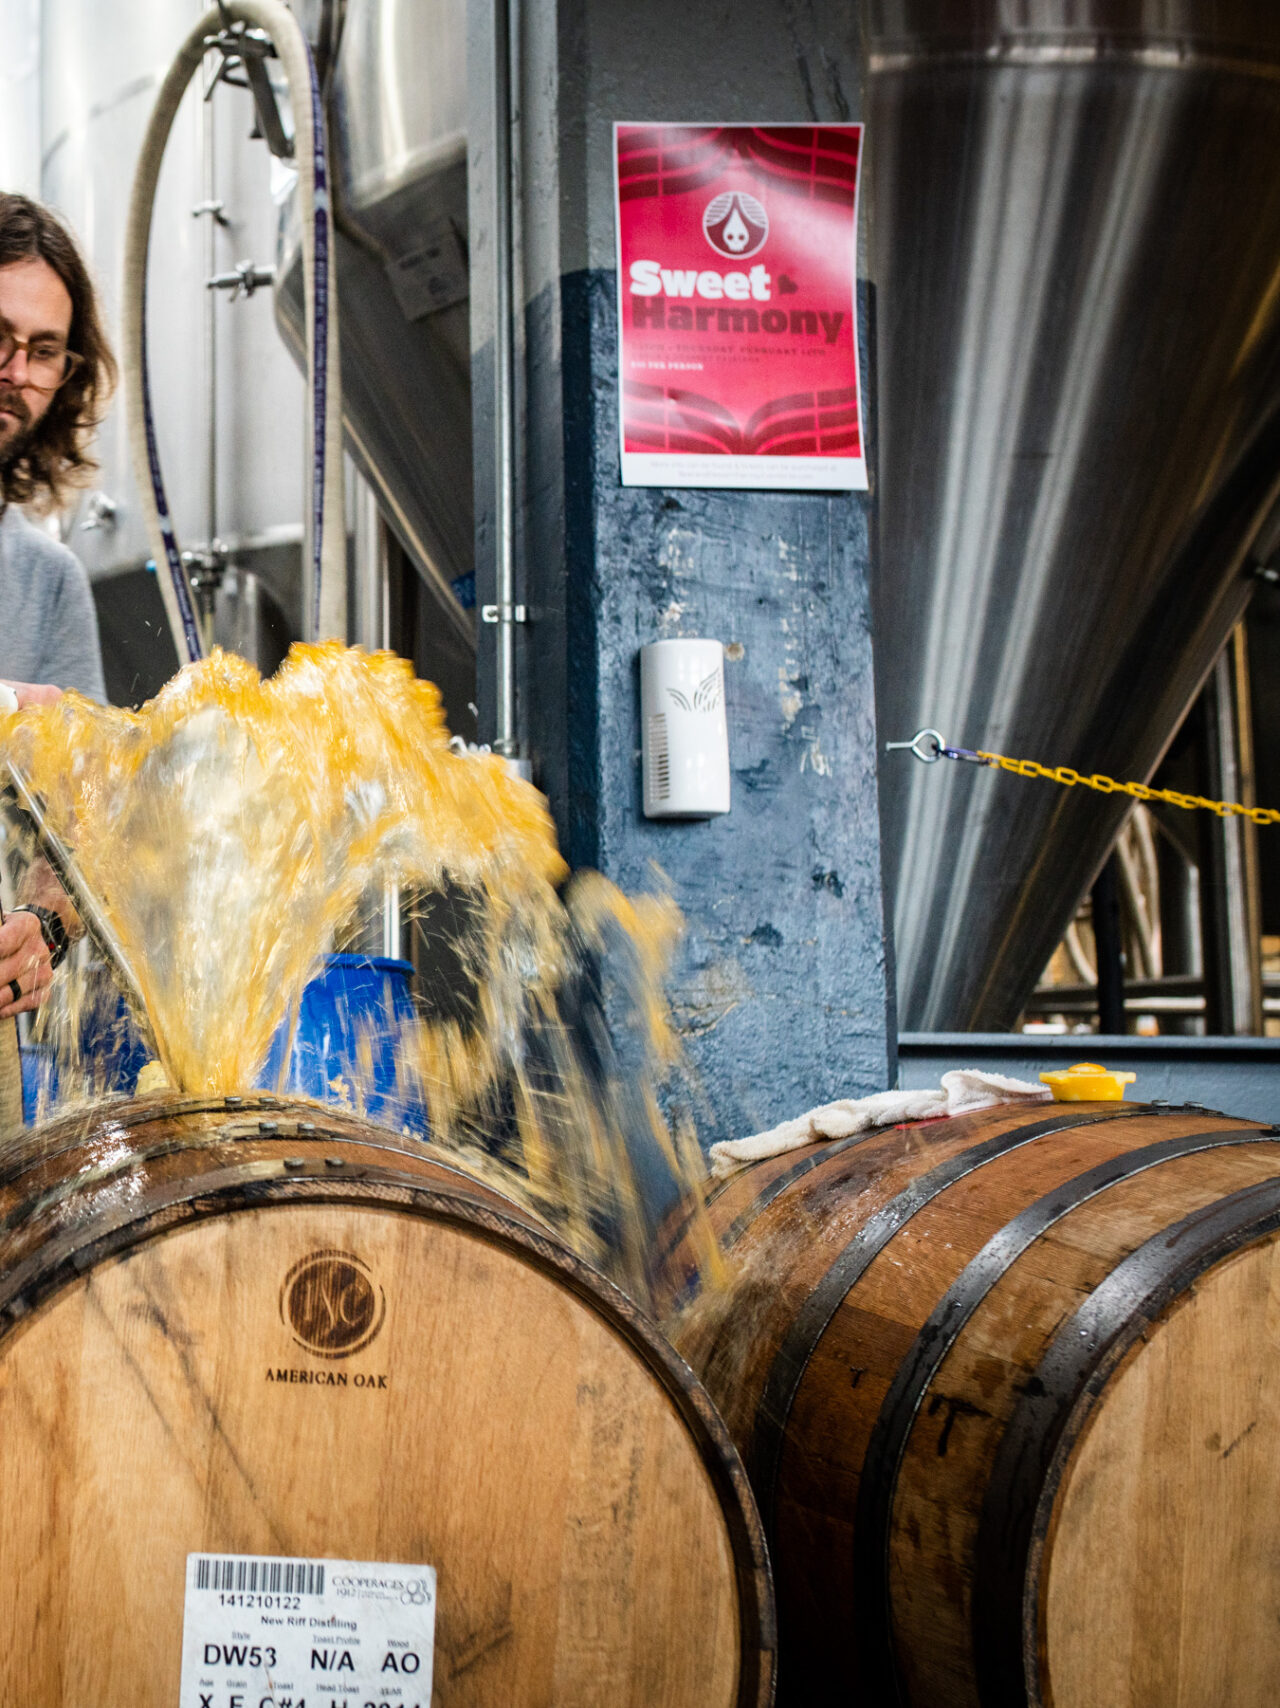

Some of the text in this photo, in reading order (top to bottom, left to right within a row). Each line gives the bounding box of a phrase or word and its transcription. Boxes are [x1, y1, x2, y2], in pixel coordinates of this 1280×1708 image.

[629, 259, 771, 301] Sweet
[631, 296, 844, 345] Harmony
[265, 1368, 387, 1389] AMERICAN OAK
[219, 1594, 301, 1610] 141210122
[261, 1615, 357, 1631] New Riff Distilling
[203, 1643, 277, 1668] DW53
[311, 1649, 355, 1672] N/A
[381, 1652, 421, 1674] AO
